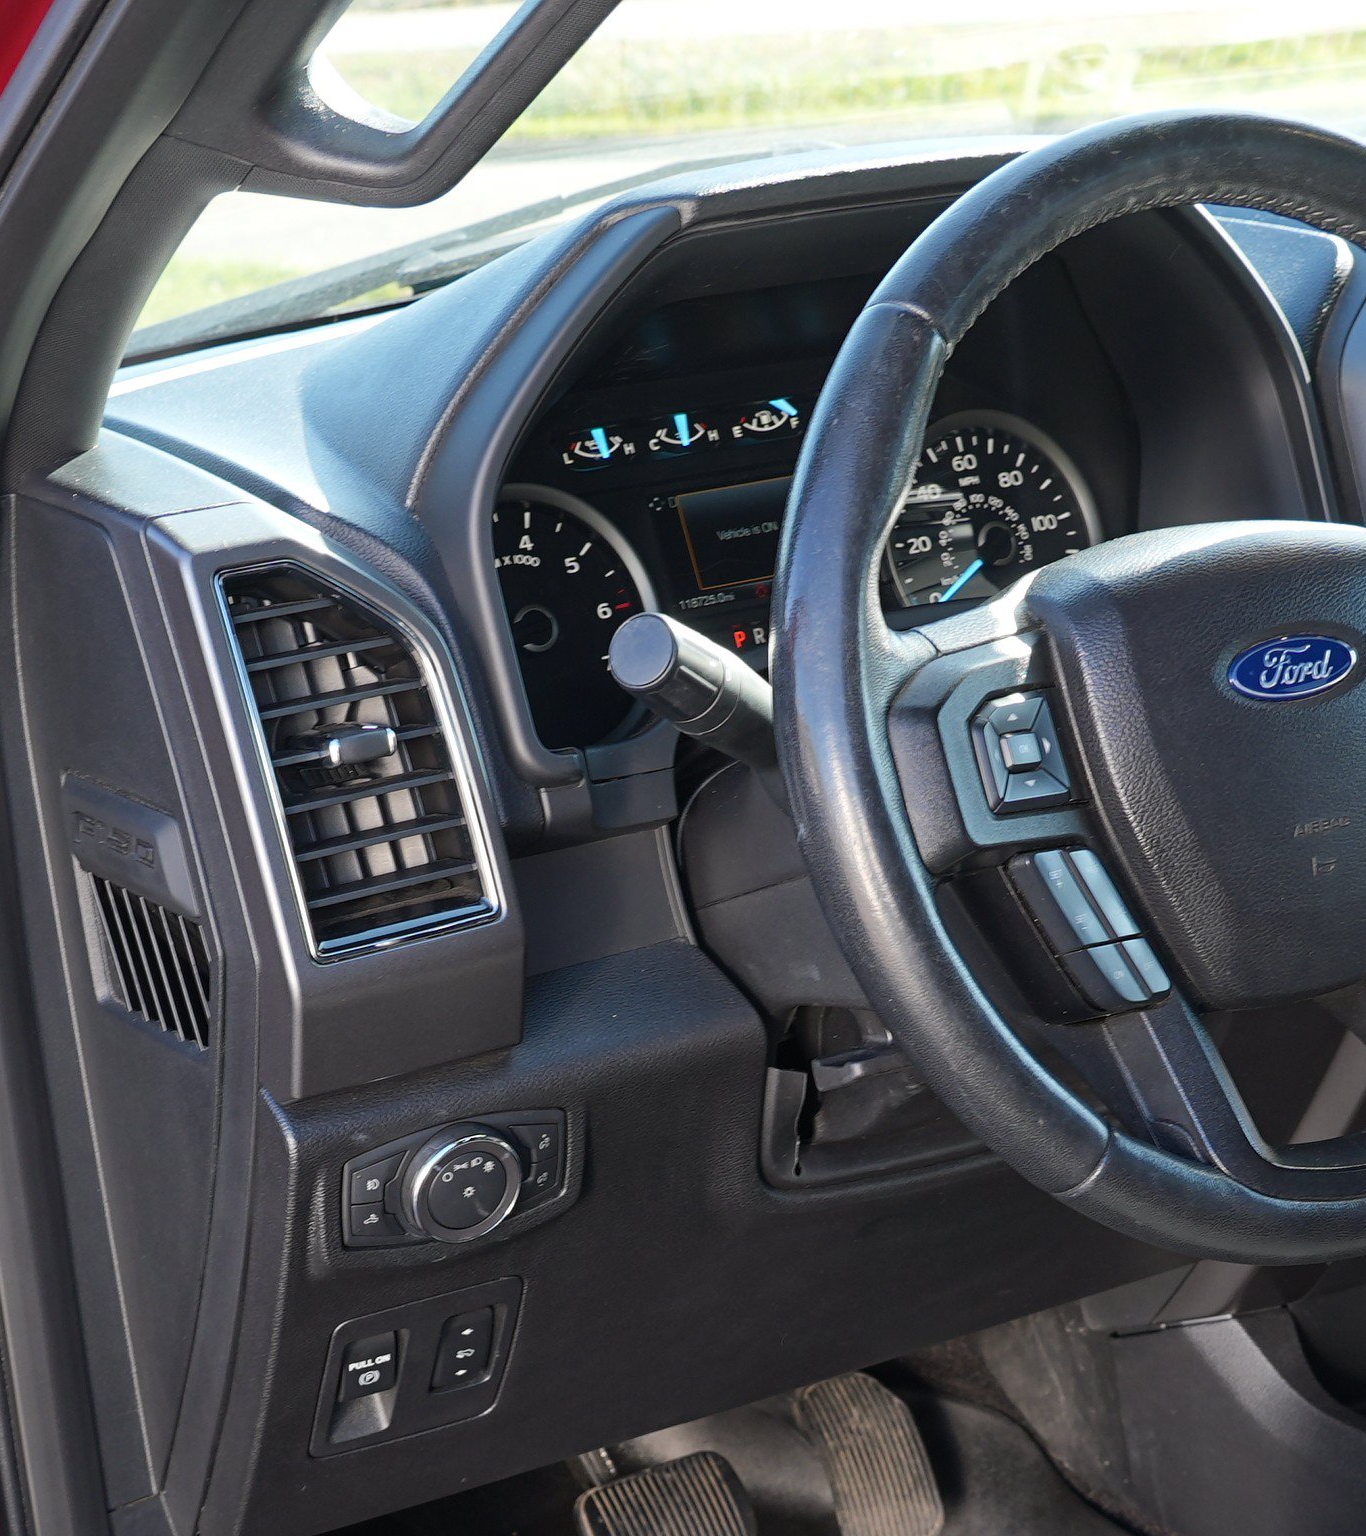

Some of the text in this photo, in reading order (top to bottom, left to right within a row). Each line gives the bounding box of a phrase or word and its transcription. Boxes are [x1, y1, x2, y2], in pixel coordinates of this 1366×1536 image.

[732, 425, 743, 438] E
[789, 417, 800, 429] F
[707, 429, 720, 442] H
[623, 443, 635, 455] H
[648, 438, 660, 451] C
[562, 452, 574, 465] L
[951, 454, 978, 472] 60
[958, 475, 981, 487] MPH
[997, 470, 1024, 488] 80
[1030, 513, 1058, 532] 100
[518, 535, 535, 551] 4
[906, 536, 932, 555] 20
[564, 556, 581, 574] 5
[596, 602, 613, 619] 6
[733, 627, 766, 648] P R
[1259, 644, 1334, 689] Ford
[1293, 815, 1352, 838] AIRBAG
[348, 1353, 391, 1372] PULL ON
